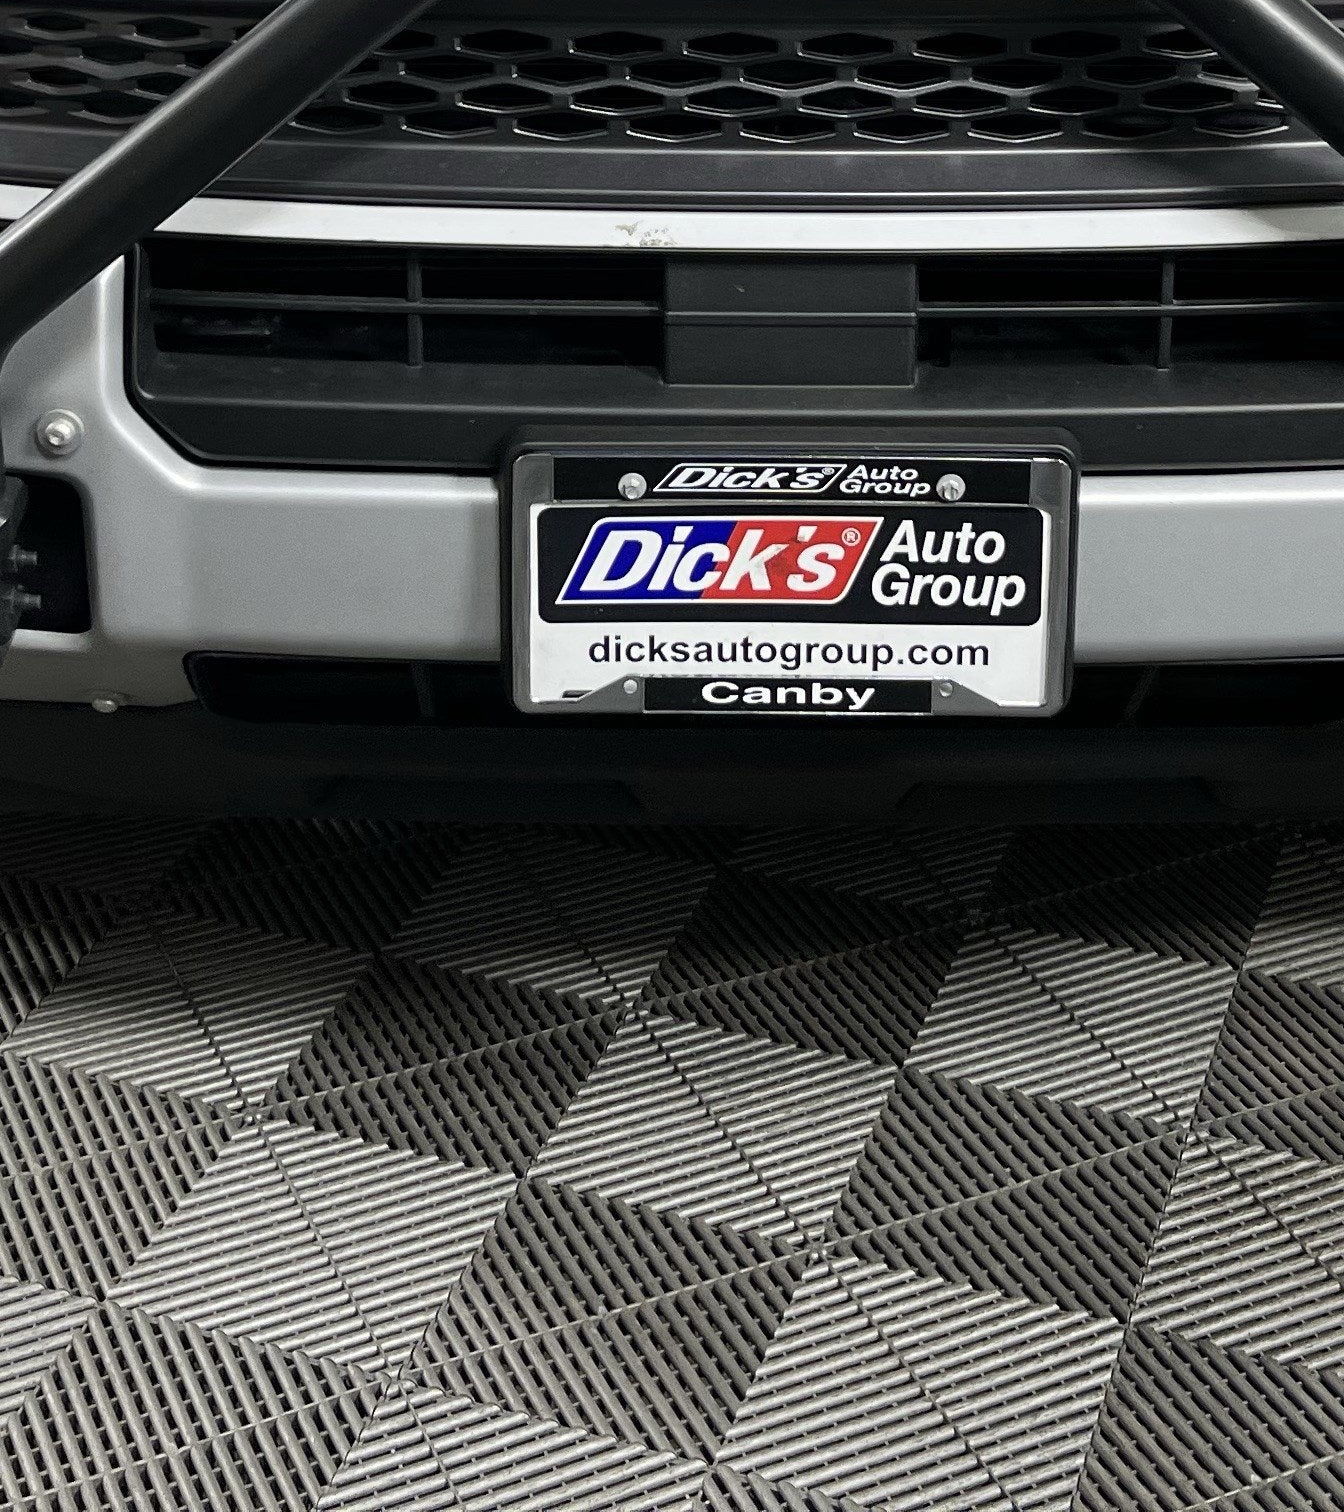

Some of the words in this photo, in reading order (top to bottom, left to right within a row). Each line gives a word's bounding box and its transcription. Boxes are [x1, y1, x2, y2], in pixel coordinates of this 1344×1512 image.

[839, 479, 931, 498] Group
[847, 464, 919, 481] Auto
[879, 519, 1005, 564] Auto
[871, 562, 1026, 616] Group
[588, 634, 990, 671] dicksautogroup.com
[701, 681, 875, 710] Canby
